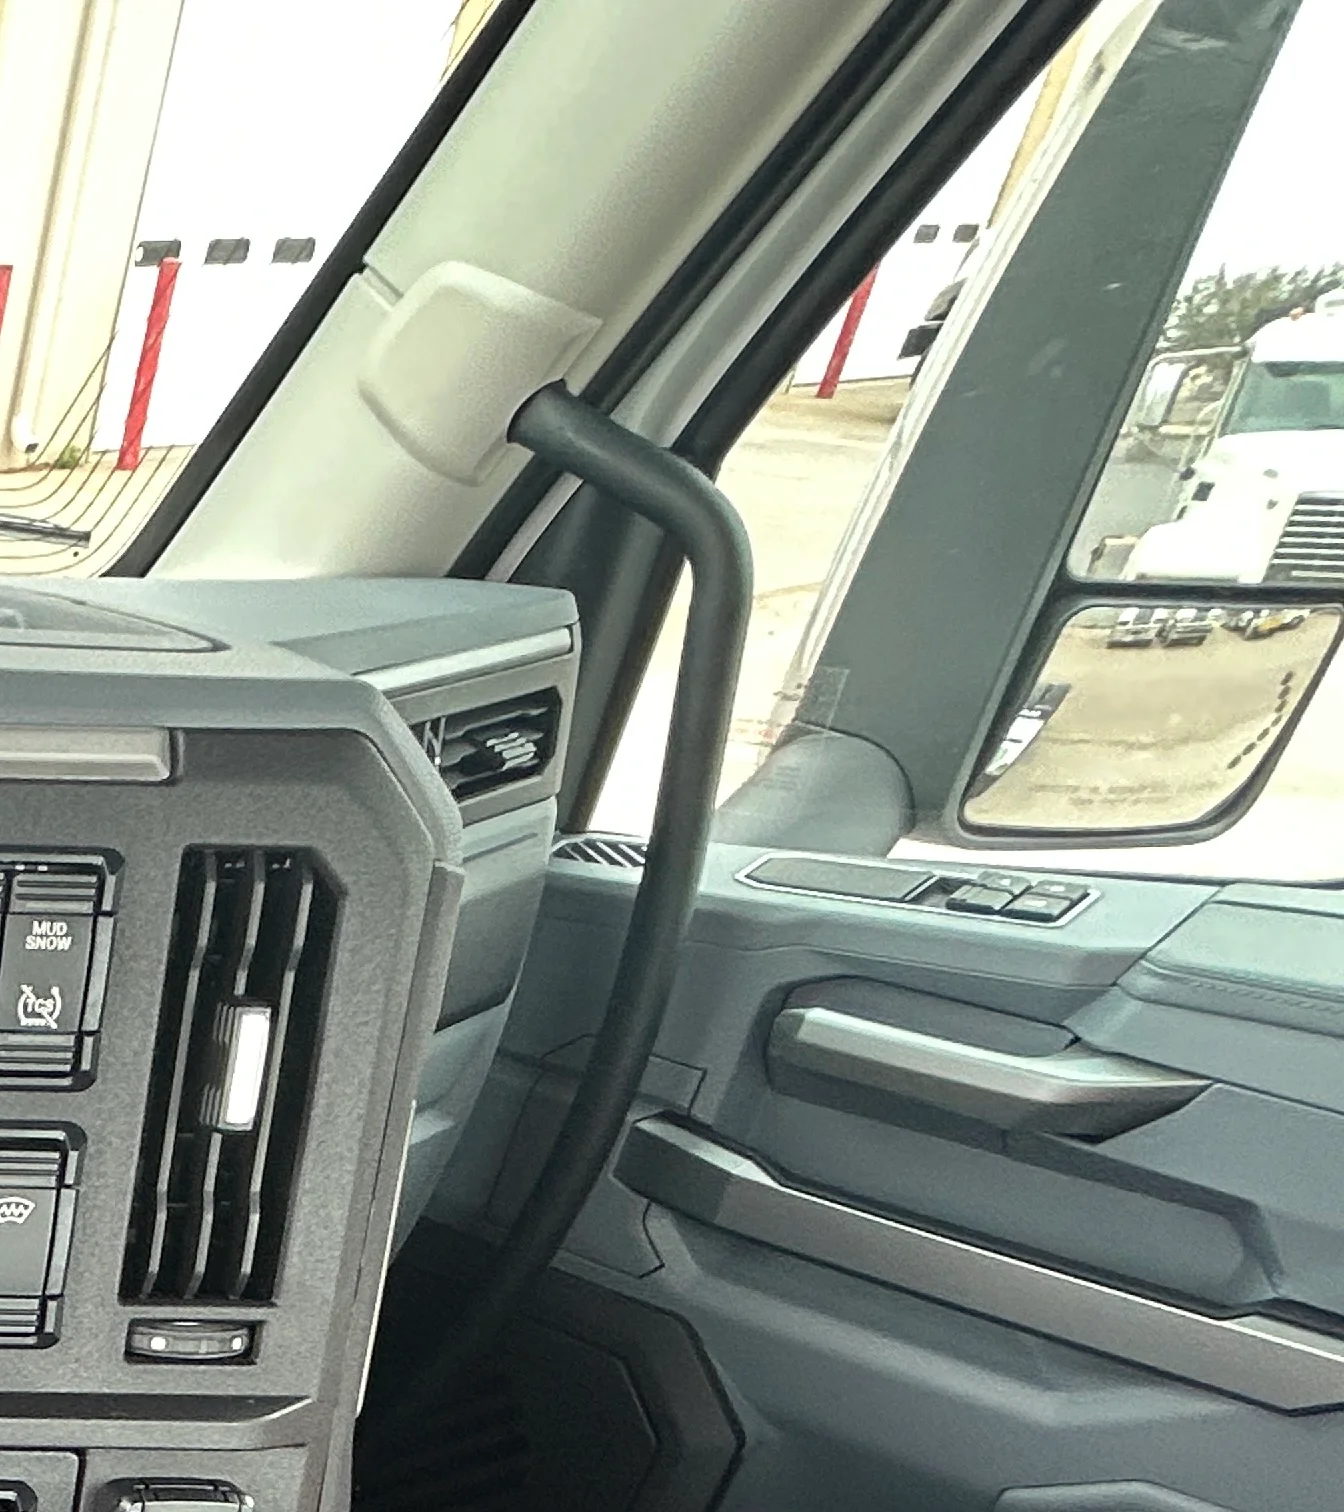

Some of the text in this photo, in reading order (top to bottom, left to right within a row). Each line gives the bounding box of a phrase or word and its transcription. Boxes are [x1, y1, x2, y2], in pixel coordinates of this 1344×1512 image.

[32, 920, 68, 936] MUD
[25, 935, 72, 951] SNOW
[26, 998, 56, 1013] TCS
